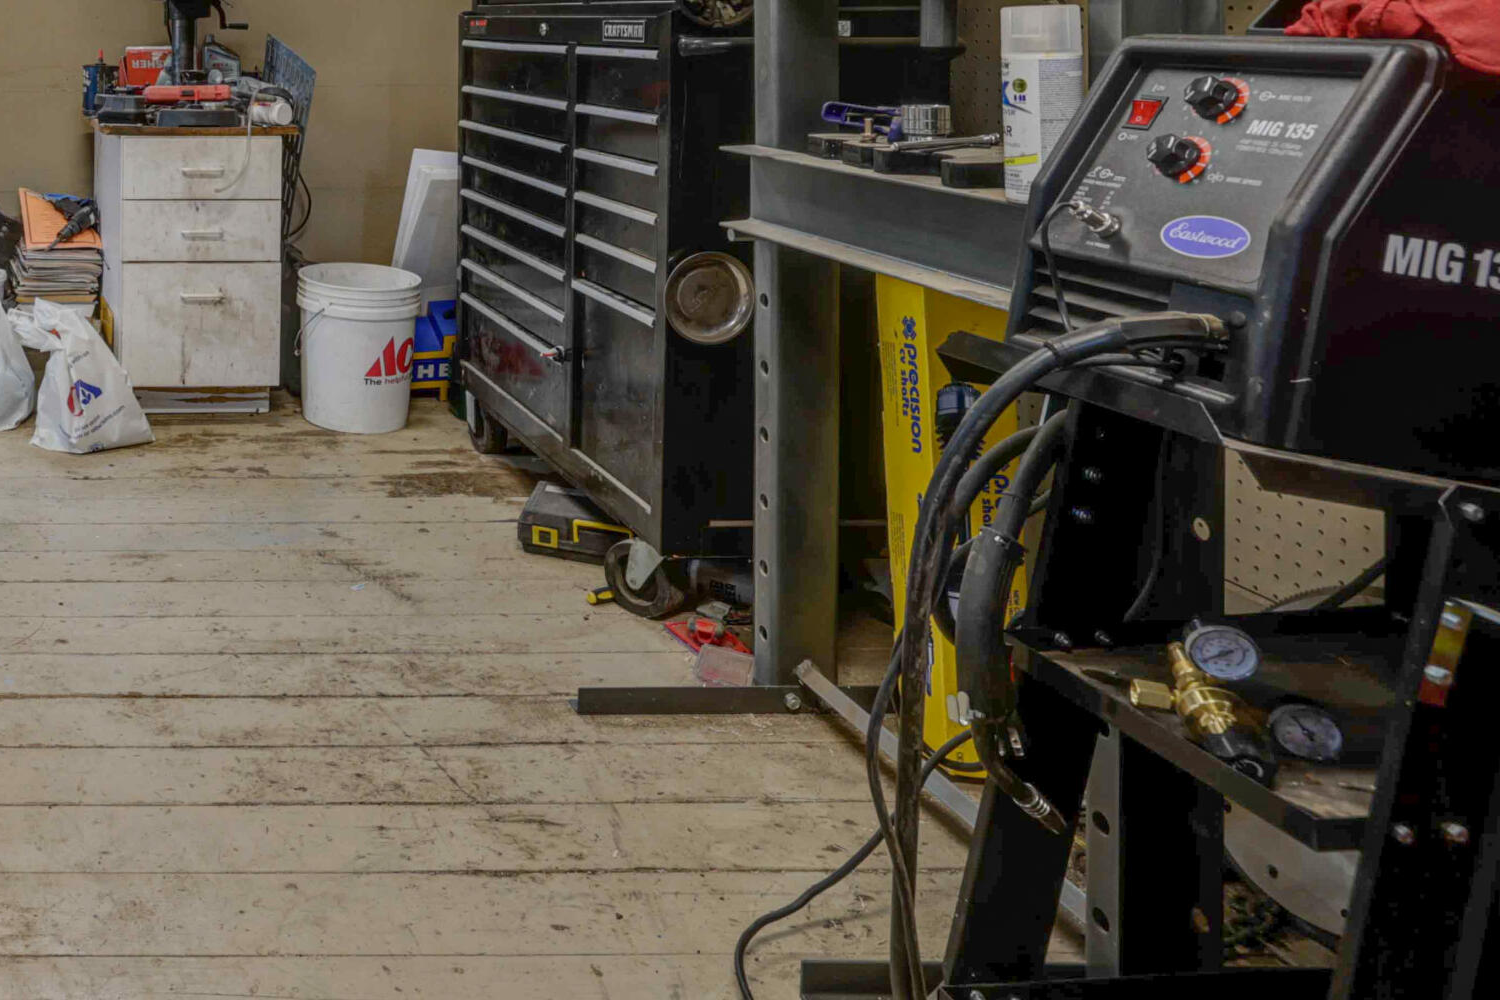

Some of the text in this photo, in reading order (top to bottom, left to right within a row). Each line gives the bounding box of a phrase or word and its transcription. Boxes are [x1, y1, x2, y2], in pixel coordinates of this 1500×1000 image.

[603, 23, 643, 39] CRAFTSMAN
[1246, 119, 1318, 140] MIG 135
[1169, 222, 1244, 250] Eastwood
[1383, 234, 1466, 284] MIG
[364, 378, 382, 386] The
[901, 370, 909, 417] shafts
[904, 344, 923, 454] precision
